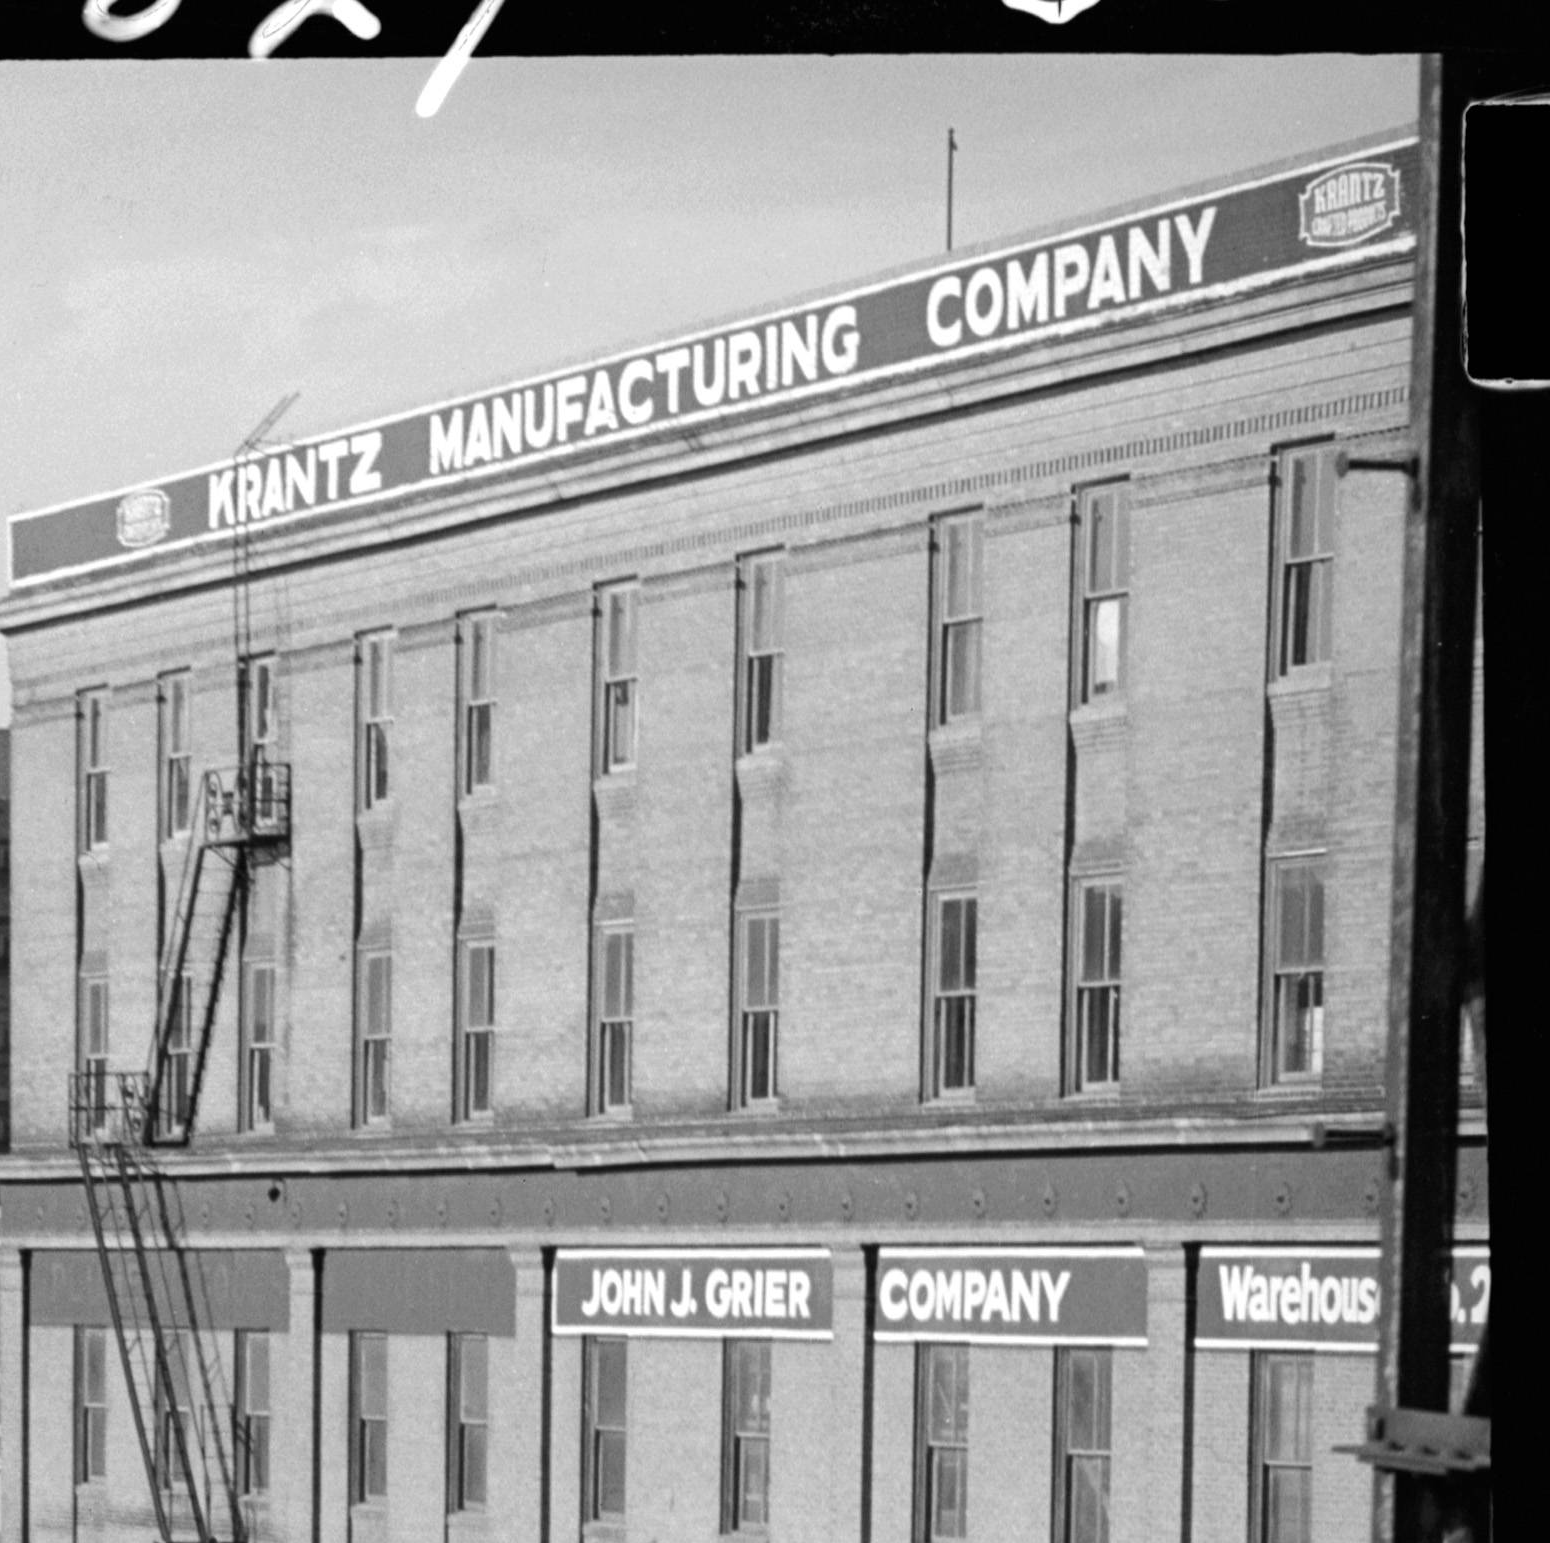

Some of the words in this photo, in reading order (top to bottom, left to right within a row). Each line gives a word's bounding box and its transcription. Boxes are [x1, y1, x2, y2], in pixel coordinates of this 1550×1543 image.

[1313, 171, 1386, 215] KRANTZ
[207, 431, 383, 530] KRANTZ
[429, 303, 861, 475] MANUFACTURING
[926, 206, 1218, 347] COMPANY
[581, 1269, 665, 1317] JOHN
[670, 1270, 698, 1318] J.
[705, 1268, 812, 1319] GRIER
[879, 1268, 1071, 1322] COMPANY
[1218, 1261, 1381, 1325] Warehous
